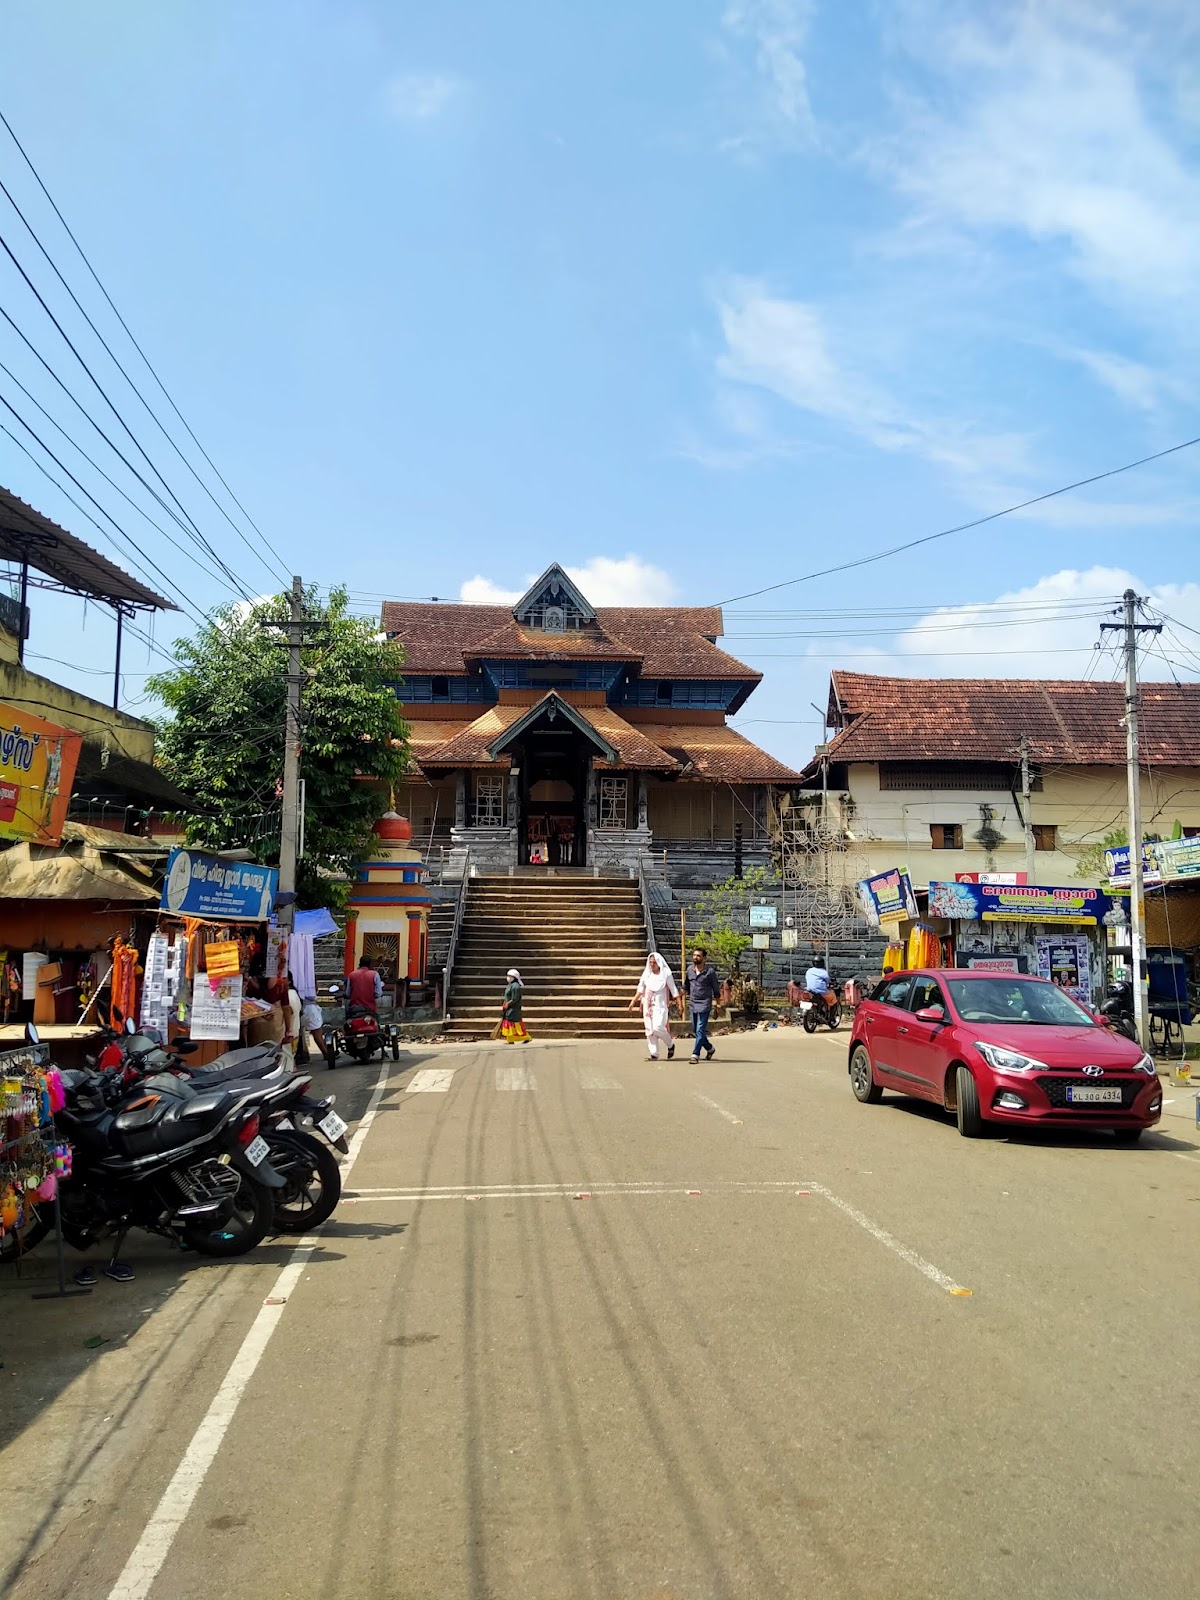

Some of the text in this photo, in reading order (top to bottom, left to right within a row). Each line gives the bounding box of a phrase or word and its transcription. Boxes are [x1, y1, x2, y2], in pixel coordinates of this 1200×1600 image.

[982, 886, 1048, 898] ദേവസ്വം
[1052, 888, 1097, 901] സ്റ്റാൾ
[973, 960, 1014, 970] തെരുവുനായ
[1102, 1091, 1121, 1100] 4334
